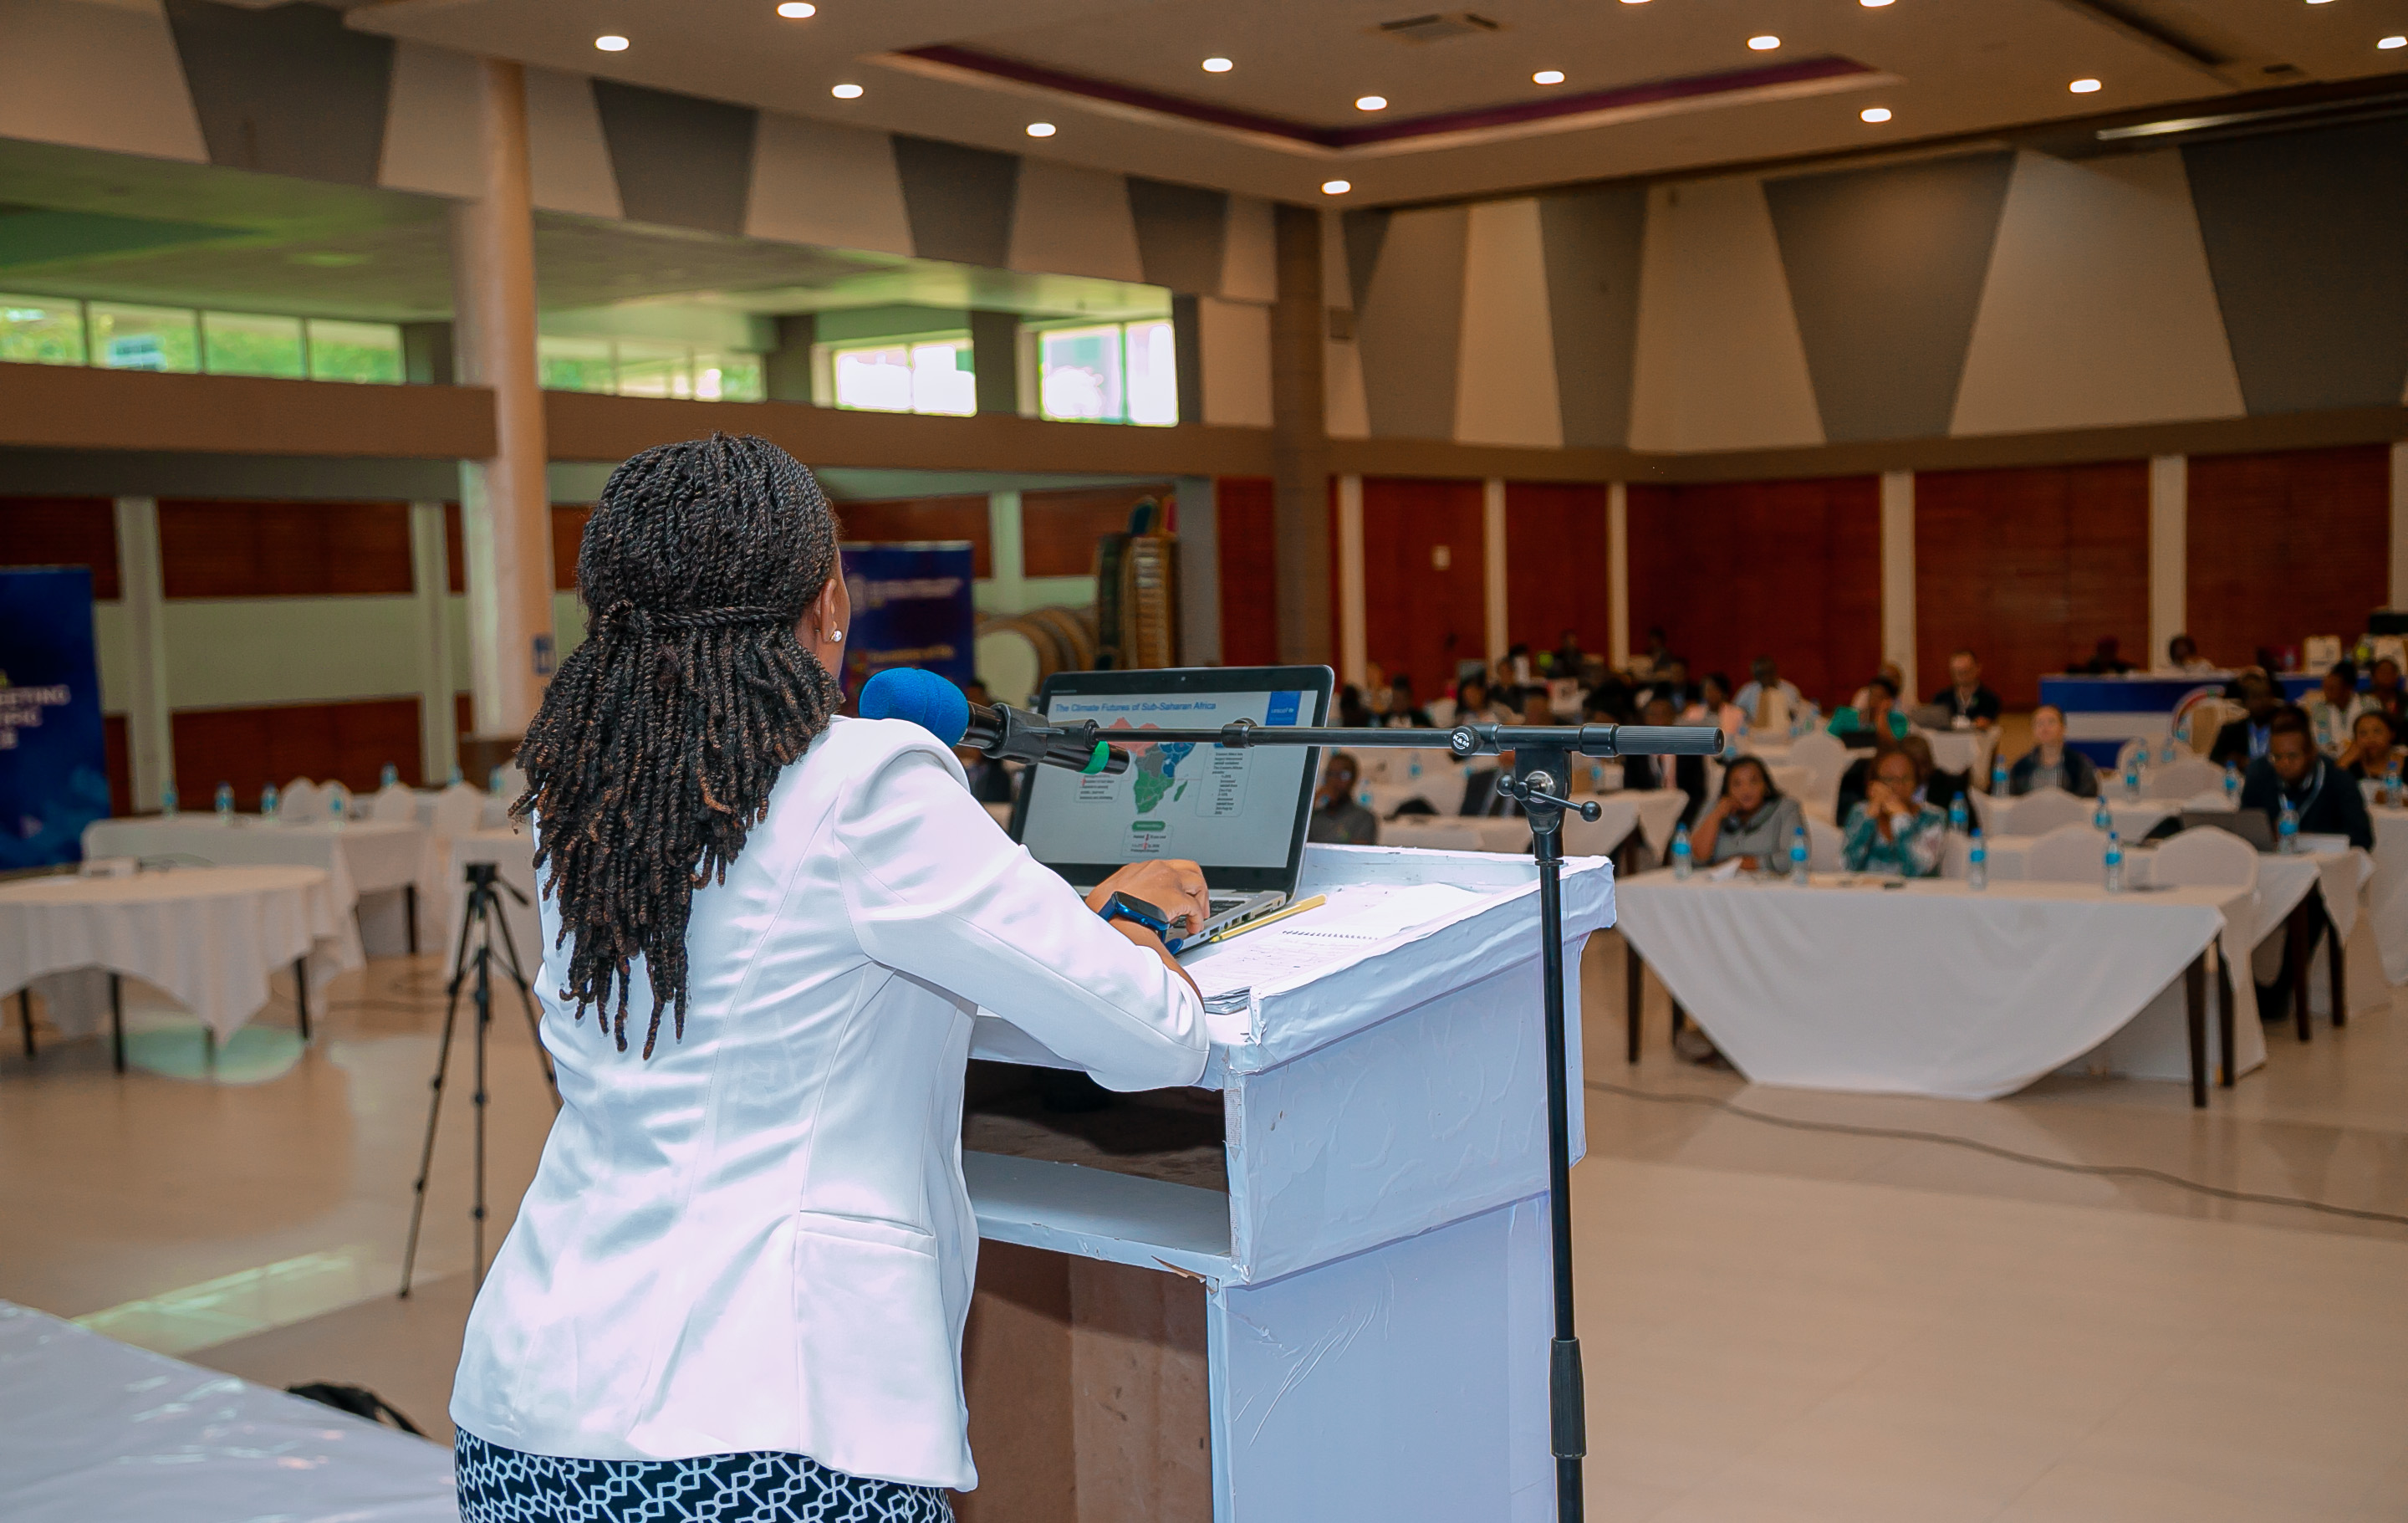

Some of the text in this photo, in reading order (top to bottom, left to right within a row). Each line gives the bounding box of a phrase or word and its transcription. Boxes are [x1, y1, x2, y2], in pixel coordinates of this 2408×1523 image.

[1055, 701, 1217, 713] The Climate Futures of Sub-Saharan Africa
[1452, 734, 1470, 748] K&M
